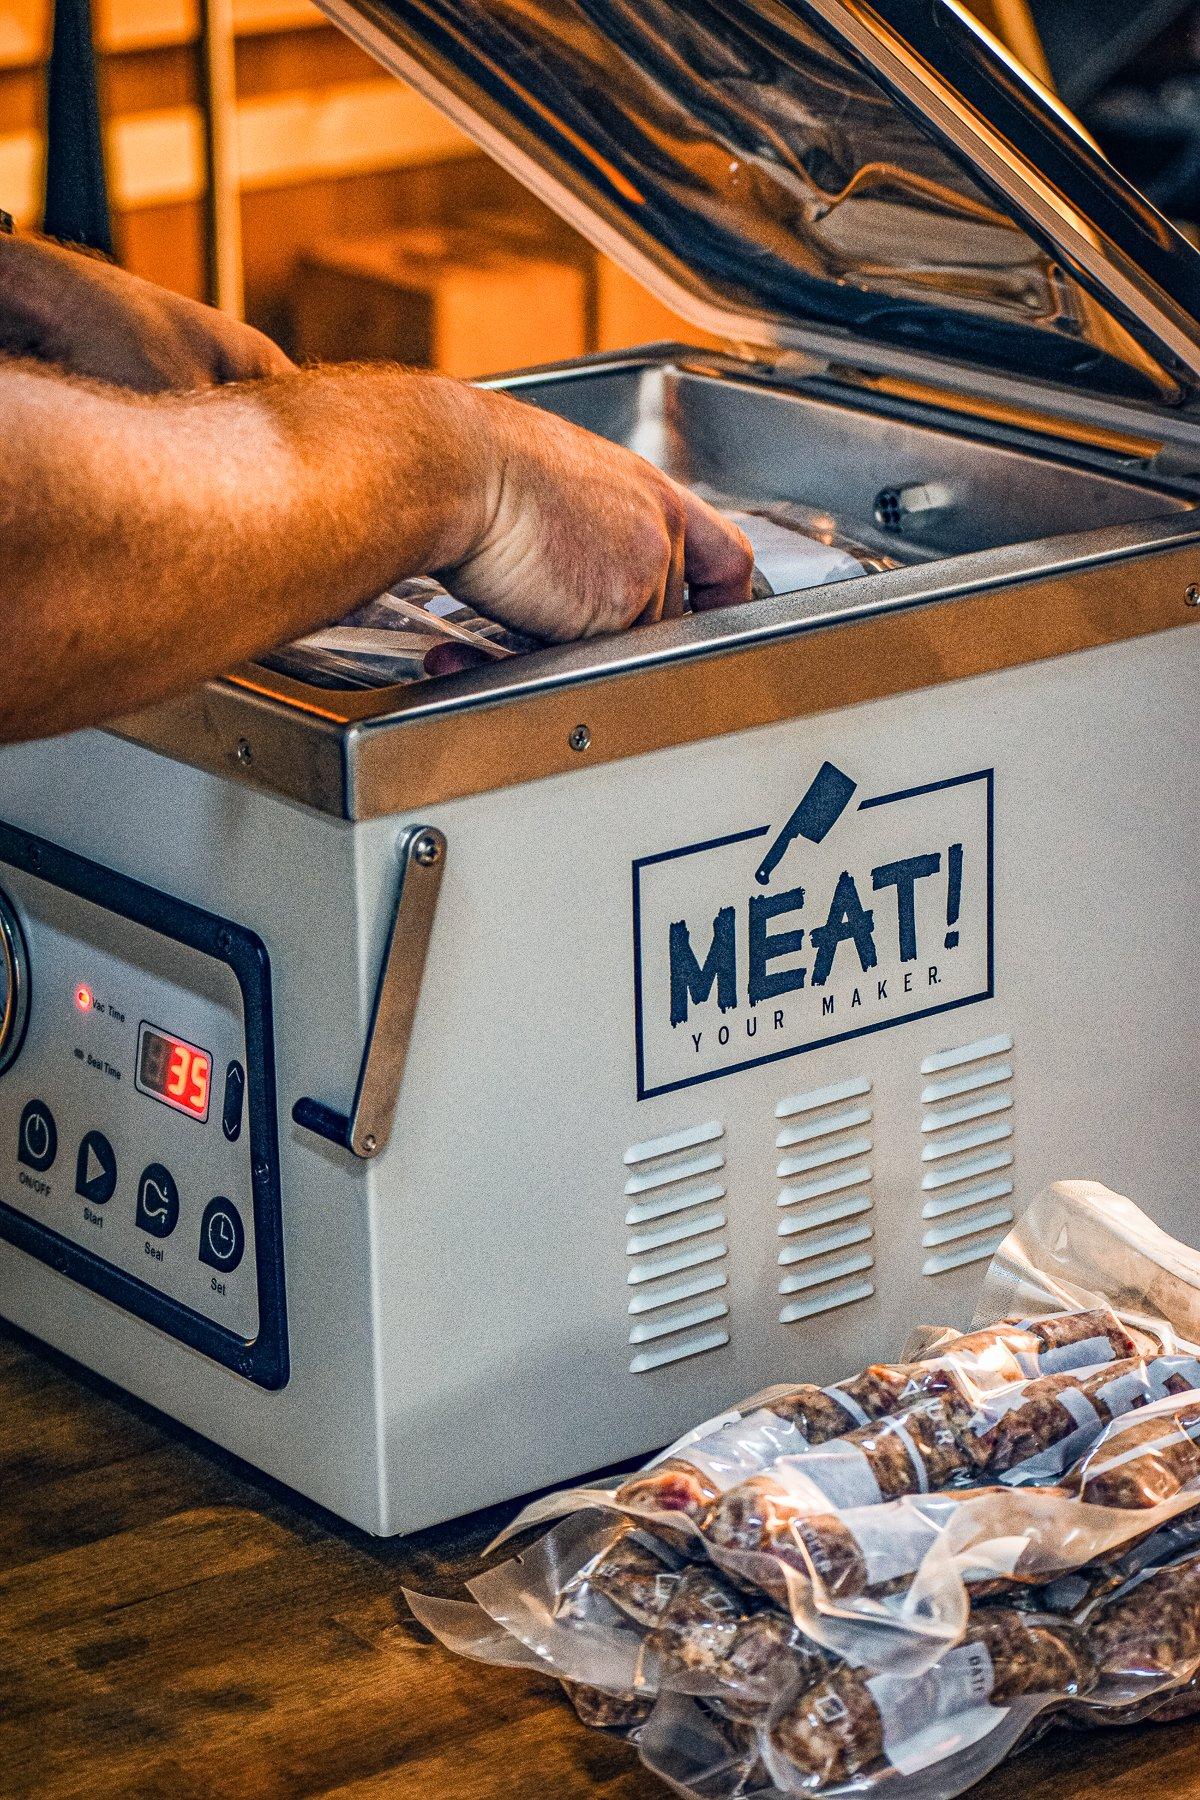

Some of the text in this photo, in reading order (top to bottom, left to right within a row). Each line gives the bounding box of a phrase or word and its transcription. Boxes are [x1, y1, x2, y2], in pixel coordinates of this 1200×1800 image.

[669, 843, 963, 1029] MEAT!
[108, 1005, 125, 1023] Time
[691, 1010, 785, 1053] YOUR
[87, 1054, 121, 1080] Seal Time
[167, 1046, 209, 1109] 35
[83, 1207, 104, 1228] Start
[144, 1241, 164, 1262] Seal
[210, 1277, 226, 1296] Set
